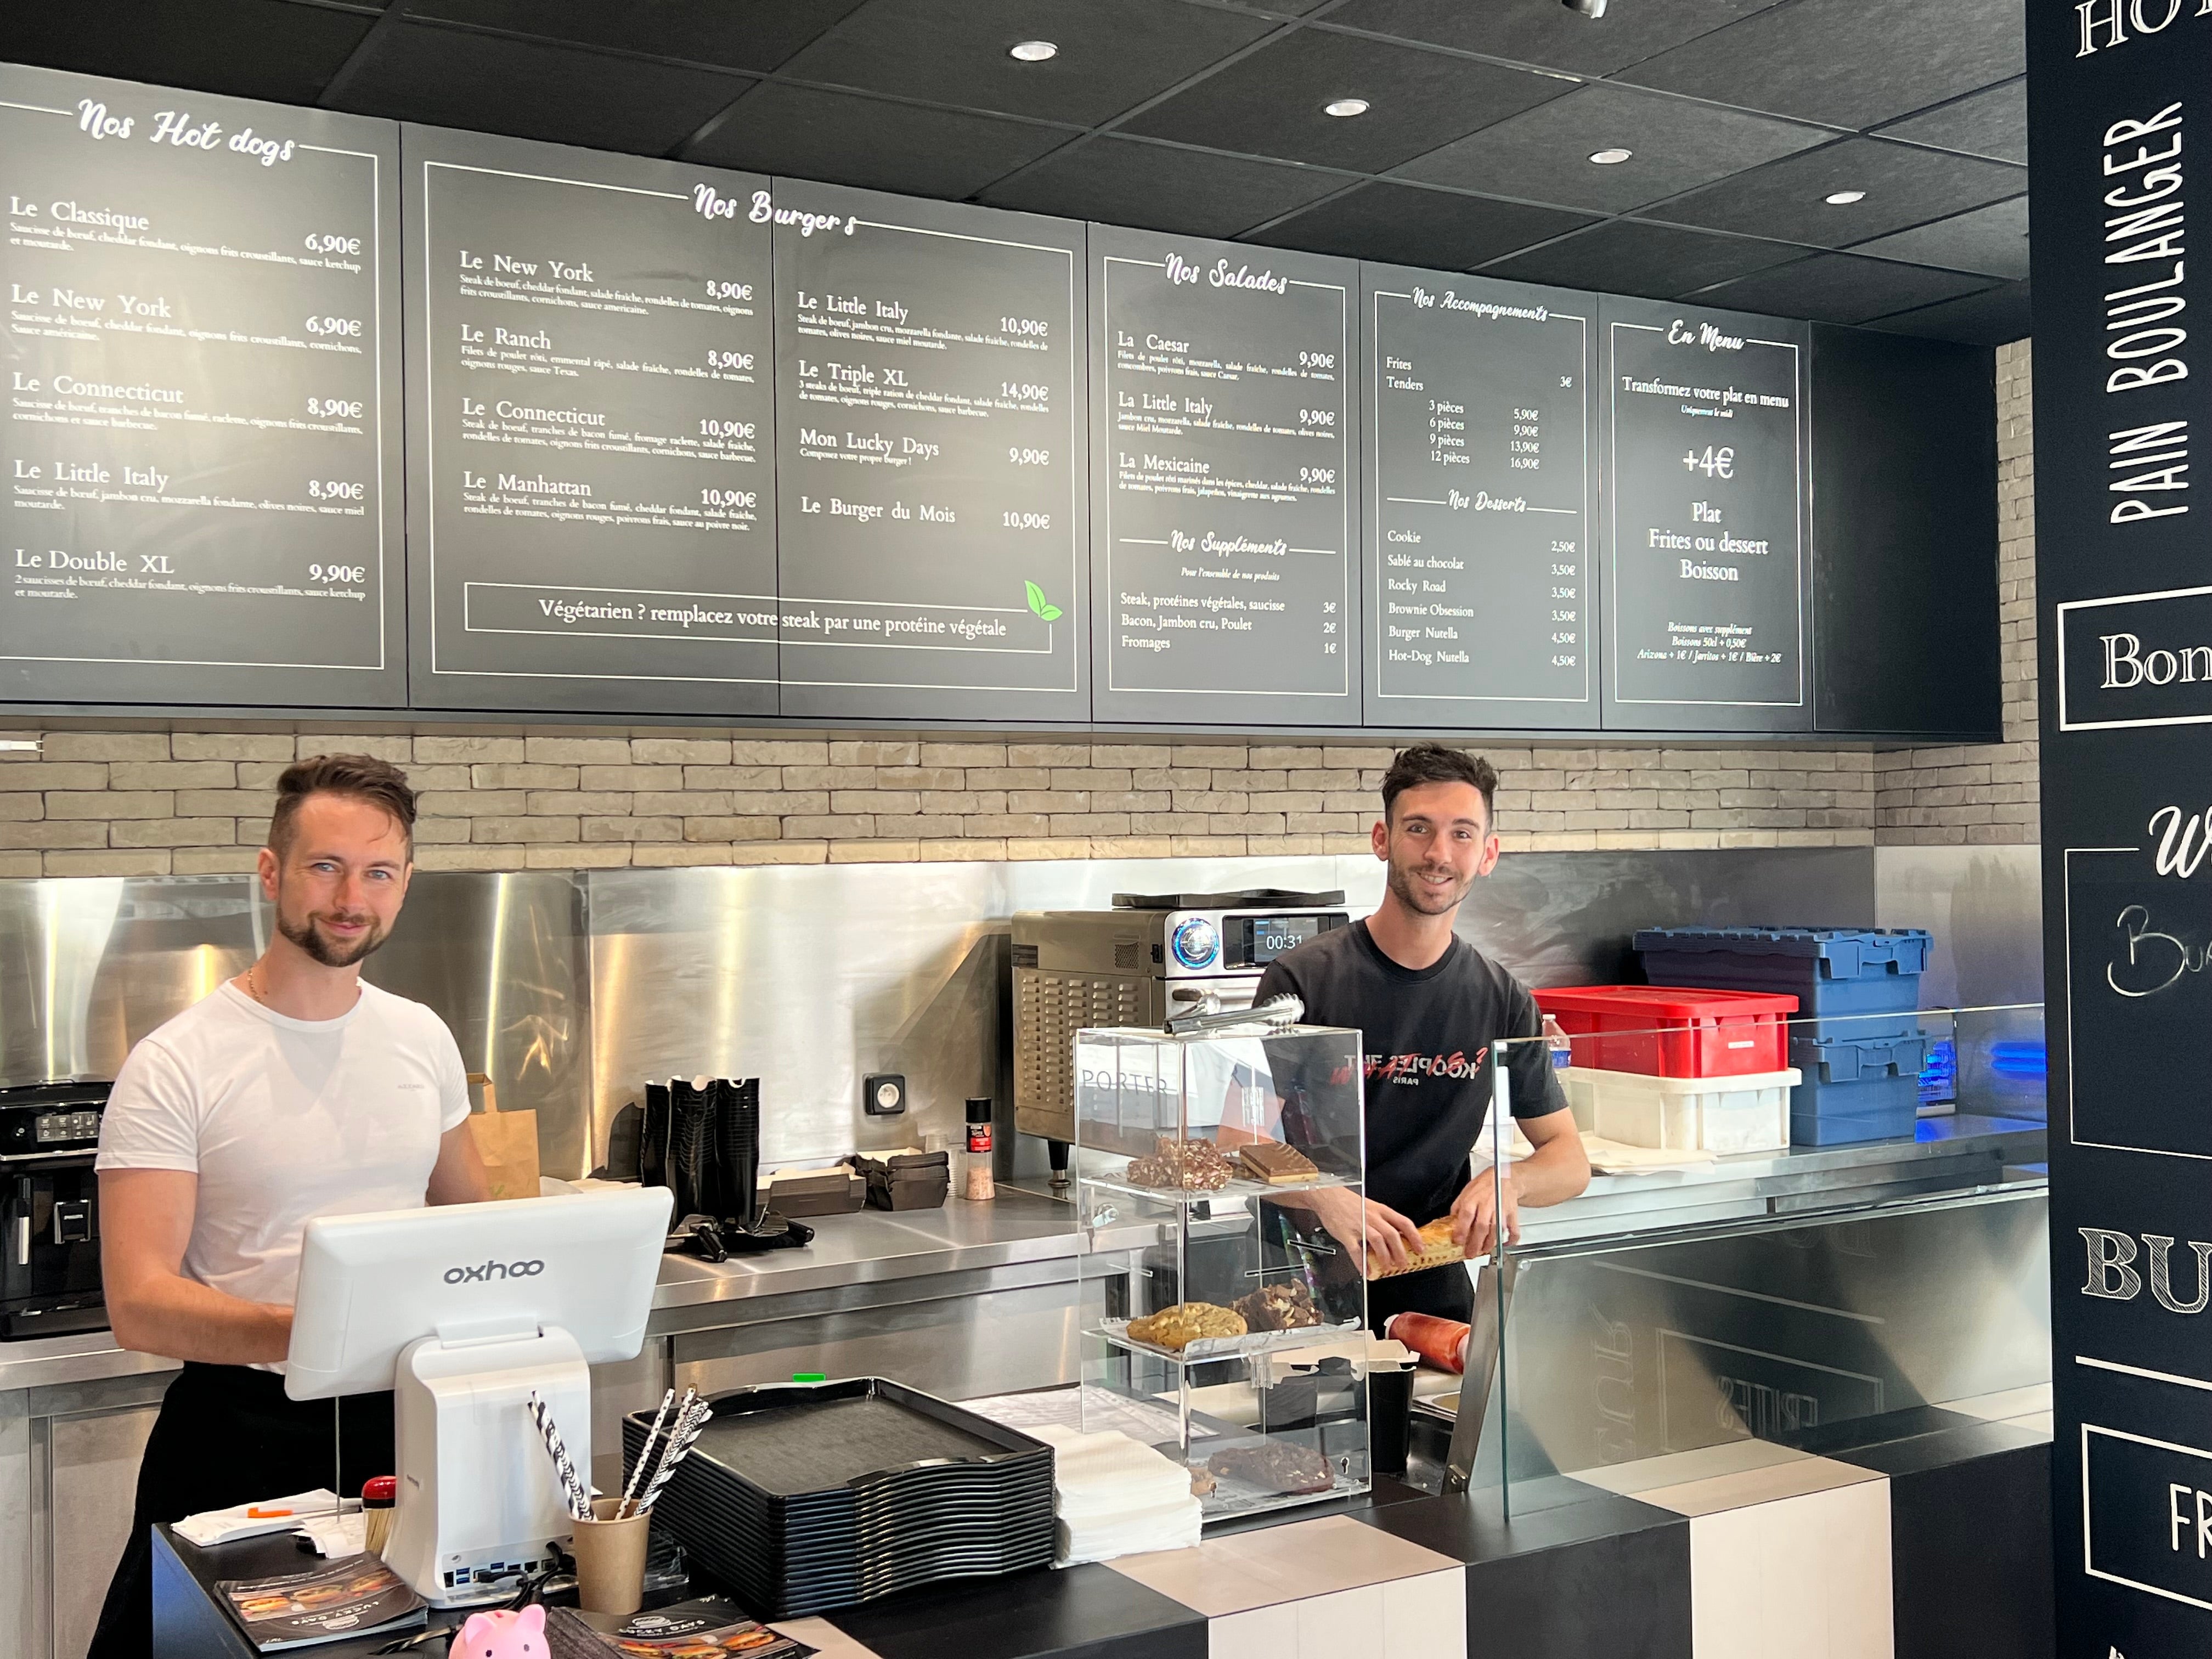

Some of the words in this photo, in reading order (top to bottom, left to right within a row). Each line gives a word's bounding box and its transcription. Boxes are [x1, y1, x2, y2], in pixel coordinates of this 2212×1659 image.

[2074, 0, 2212, 58] HO
[78, 99, 134, 139] Nos
[150, 111, 222, 149] Hot
[229, 128, 295, 166] dogs
[694, 184, 737, 219] Nos
[10, 196, 37, 217] Le
[51, 201, 149, 237] Classique
[306, 234, 360, 255] 6,90€
[2103, 101, 2188, 393] BOULANGER
[460, 251, 482, 269] Le
[494, 255, 538, 275] New
[549, 261, 594, 282] York
[707, 280, 752, 300] 8,90€
[1166, 253, 1199, 285] Nos
[1209, 259, 1287, 294] Salades
[12, 284, 38, 304] Le
[53, 289, 105, 311] New
[117, 295, 171, 317] York
[306, 316, 361, 336] 6,90€
[798, 292, 817, 309] Le
[827, 295, 866, 314] Little
[876, 301, 908, 325] Italy
[1001, 317, 1048, 336] 10,90€
[1413, 287, 1435, 308] Nos
[1440, 291, 1547, 321] Accompagnements
[461, 324, 483, 342] Le
[495, 328, 551, 349] Ranch
[708, 351, 753, 370] 8,90€
[1118, 331, 1133, 347] La
[1147, 335, 1189, 353] Caesar
[1300, 352, 1334, 368] 9,90€
[1668, 320, 1695, 344] En
[1700, 323, 1744, 351] Menu
[799, 360, 818, 377] Le
[827, 363, 874, 388] Triple
[883, 369, 908, 386] XL
[1002, 382, 1048, 400] 14,90€
[1386, 376, 1423, 391] Tenders
[1387, 357, 1411, 370] Frites
[1560, 376, 1571, 387] 3€
[13, 372, 40, 391] Le
[54, 376, 183, 403] Connecticut
[308, 398, 362, 418] 8,90€
[1430, 400, 1435, 410] 3
[1437, 401, 1463, 415] pièces
[1622, 377, 1691, 397] Transformez
[1694, 388, 1720, 400] votre
[1723, 386, 1743, 405] plat
[1745, 394, 1757, 404] en
[1760, 396, 1788, 407] menu
[463, 398, 484, 415] Le
[496, 401, 605, 426] Connecticut
[700, 419, 755, 439] 10,90€
[1119, 392, 1135, 407] La
[1143, 394, 1176, 411] Little
[1186, 397, 1212, 424] Italy
[1300, 409, 1334, 426] 9,90€
[800, 428, 837, 447] Mon
[847, 432, 894, 458] Lucky
[902, 437, 940, 461] Days
[1009, 448, 1049, 465] 9,90€
[1432, 450, 1441, 461] 12
[1443, 452, 1470, 465] pièces
[1683, 446, 1733, 478] +4€
[14, 460, 41, 478] Le
[55, 462, 110, 483] Little
[124, 466, 168, 493] Italy
[309, 481, 363, 500] 8,90€
[1120, 453, 1136, 468] La
[1144, 454, 1209, 473] Mexicaine
[1300, 467, 1335, 483] 9,90€
[2109, 420, 2188, 524] PAIN
[464, 471, 486, 488] Le
[498, 474, 591, 496] Manhattan
[702, 489, 756, 508] 10,90€
[1449, 489, 1469, 510] Nos
[1475, 492, 1526, 512] Desserts
[802, 496, 820, 513] Le
[830, 499, 883, 522] Burger
[892, 501, 910, 519] du
[920, 505, 955, 522] Mois
[1003, 512, 1049, 529] 10,90€
[1692, 501, 1721, 523] Plat
[1171, 530, 1195, 552] Nos
[1201, 532, 1286, 557] Suppléments
[1388, 531, 1420, 543] Cookie
[1649, 528, 1691, 549] Frites
[1695, 538, 1715, 551] ou
[1719, 531, 1768, 554] dessert
[16, 549, 41, 567] Le
[49, 551, 127, 571] Double
[140, 555, 174, 573] XL
[309, 565, 365, 583] 9,90€
[1388, 554, 1411, 566] Sablé
[1427, 556, 1464, 569] chocolat
[1680, 559, 1738, 580] Boisson
[1389, 578, 1417, 595] Rocky
[1423, 580, 1446, 592] Road
[539, 600, 633, 623] Végétarien
[651, 605, 733, 628] remplacez
[737, 613, 777, 625] votre
[782, 611, 820, 628] steak
[824, 618, 849, 634] par
[853, 619, 881, 630] une
[885, 617, 945, 636] protéine
[950, 619, 1006, 640] végétale
[1154, 595, 1198, 610] protéines
[1249, 599, 1285, 611] saucisse
[1324, 602, 1336, 613] 3€
[1157, 615, 1197, 631] Jambon
[1222, 617, 1252, 630] Poulet
[1324, 623, 1336, 633] 2€
[1122, 635, 1170, 652] Fromages
[1325, 643, 1336, 653] 1€
[1389, 650, 1432, 665] Hot-Dog
[1437, 651, 1469, 662] Nutella
[1266, 935, 1302, 950] 00:31
[443, 1258, 545, 1285] oxhoo
